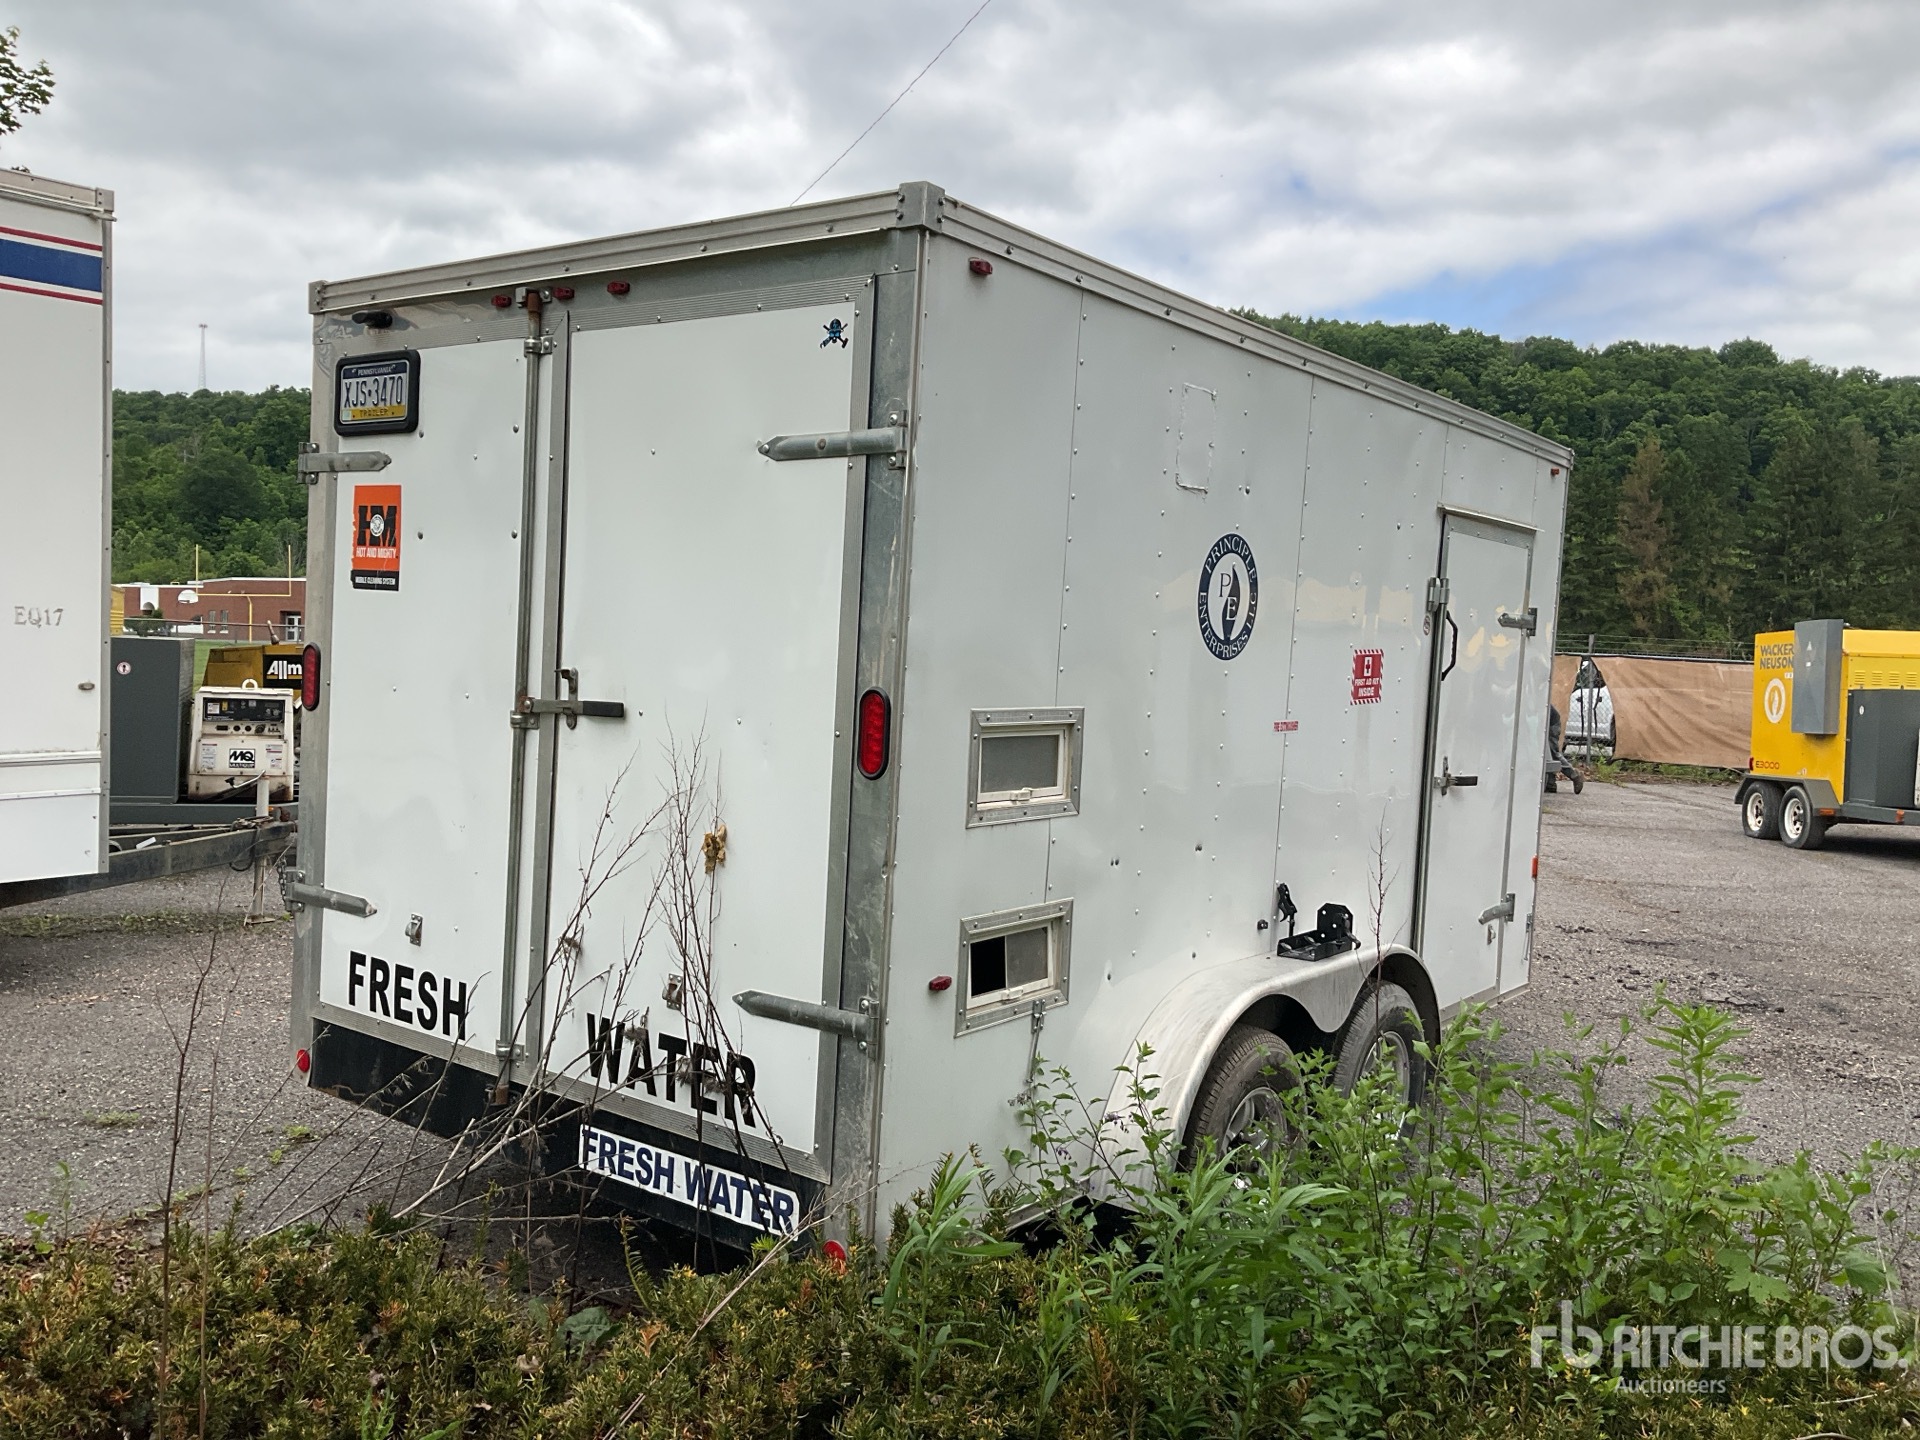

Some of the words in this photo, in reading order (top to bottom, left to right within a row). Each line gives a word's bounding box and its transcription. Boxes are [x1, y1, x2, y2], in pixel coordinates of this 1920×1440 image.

[358, 366, 391, 376] PENNSYLVANIA
[359, 409, 388, 417] TRAILER
[356, 547, 366, 557] HOT
[366, 548, 376, 558] AND
[377, 548, 396, 558] MIGHTY
[1205, 536, 1257, 583] PRINCIPLE
[1219, 572, 1232, 598] P
[1225, 596, 1238, 620] E
[14, 605, 63, 628] EQ17
[1199, 592, 1249, 658] ENTERPRISES
[1246, 592, 1257, 629] LLC
[1760, 643, 1794, 656] WACKER
[1760, 656, 1794, 669] NEUSON
[266, 660, 302, 679] Allm
[1354, 678, 1365, 686] FIRST
[1358, 687, 1374, 696] INSIDE
[230, 750, 255, 762] MQ
[1755, 760, 1780, 770] E3000
[349, 951, 467, 1041] FRESH
[586, 1012, 757, 1128] WATER
[582, 1131, 674, 1194] FRESH
[684, 1160, 794, 1238] WATER
